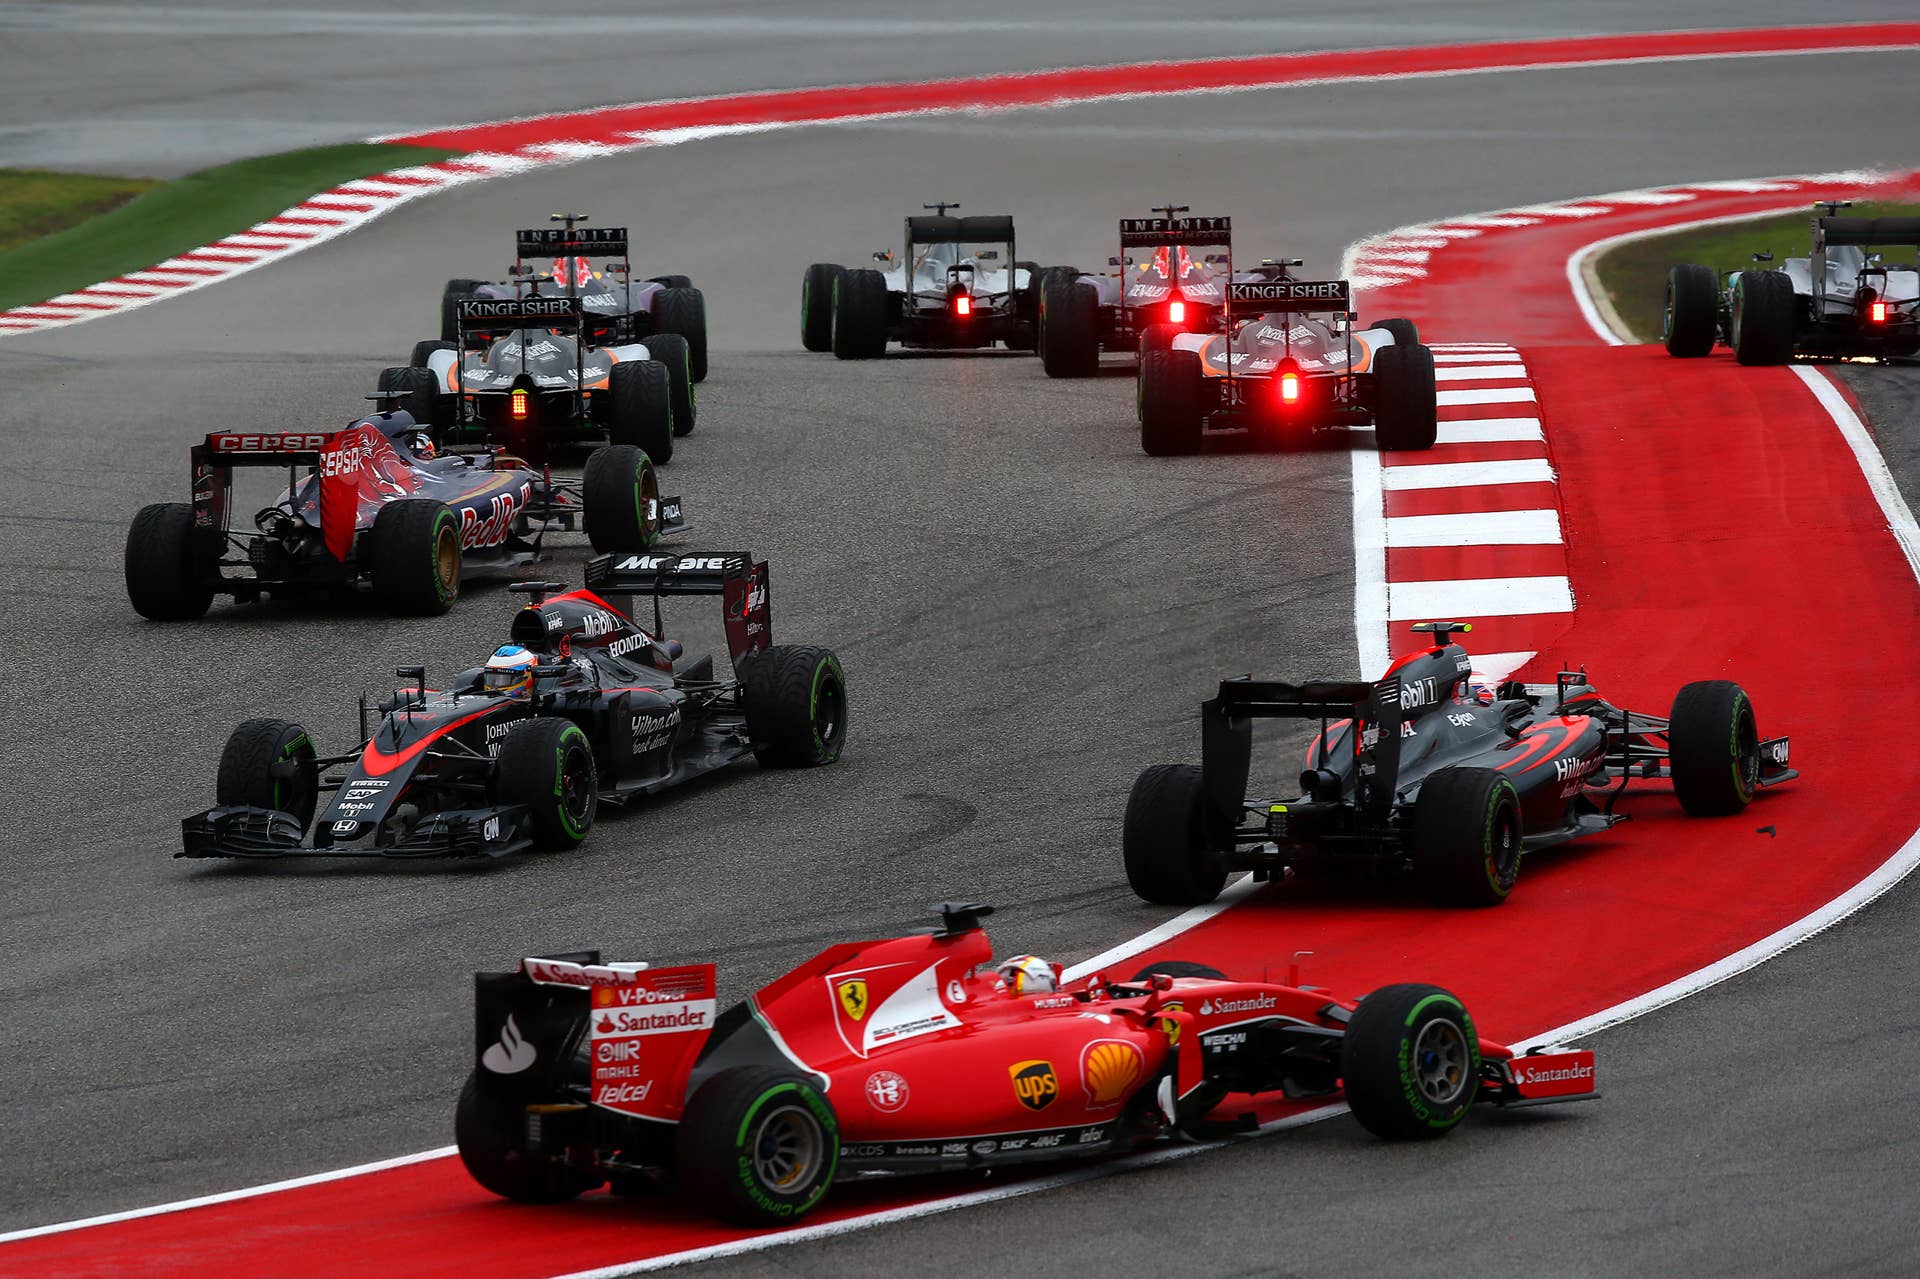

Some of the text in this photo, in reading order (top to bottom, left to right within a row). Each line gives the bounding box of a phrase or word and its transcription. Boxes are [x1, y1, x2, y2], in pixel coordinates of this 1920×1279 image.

[1123, 219, 1228, 231] INFINITI
[519, 229, 625, 242] INFINITI
[1231, 283, 1342, 299] KINGFISHER
[463, 300, 572, 317] KINGFISHER
[219, 436, 325, 450] CEPSA
[320, 447, 359, 478] CEPSA
[583, 610, 613, 637] Mobil
[608, 631, 651, 658] HONDA
[347, 790, 373, 799] SAP
[483, 816, 500, 841] CNN
[1034, 997, 1074, 1009] HUBLOT
[1214, 992, 1277, 1014] Santander
[618, 1006, 707, 1032] Santander
[1203, 1032, 1247, 1047] WEICHAI
[596, 1065, 641, 1080] MAHLE
[1526, 1061, 1594, 1084] Santander
[597, 1080, 653, 1104] telcel
[1016, 1073, 1056, 1105] ups
[895, 1146, 938, 1155] brembo
[942, 1143, 968, 1154] NGK
